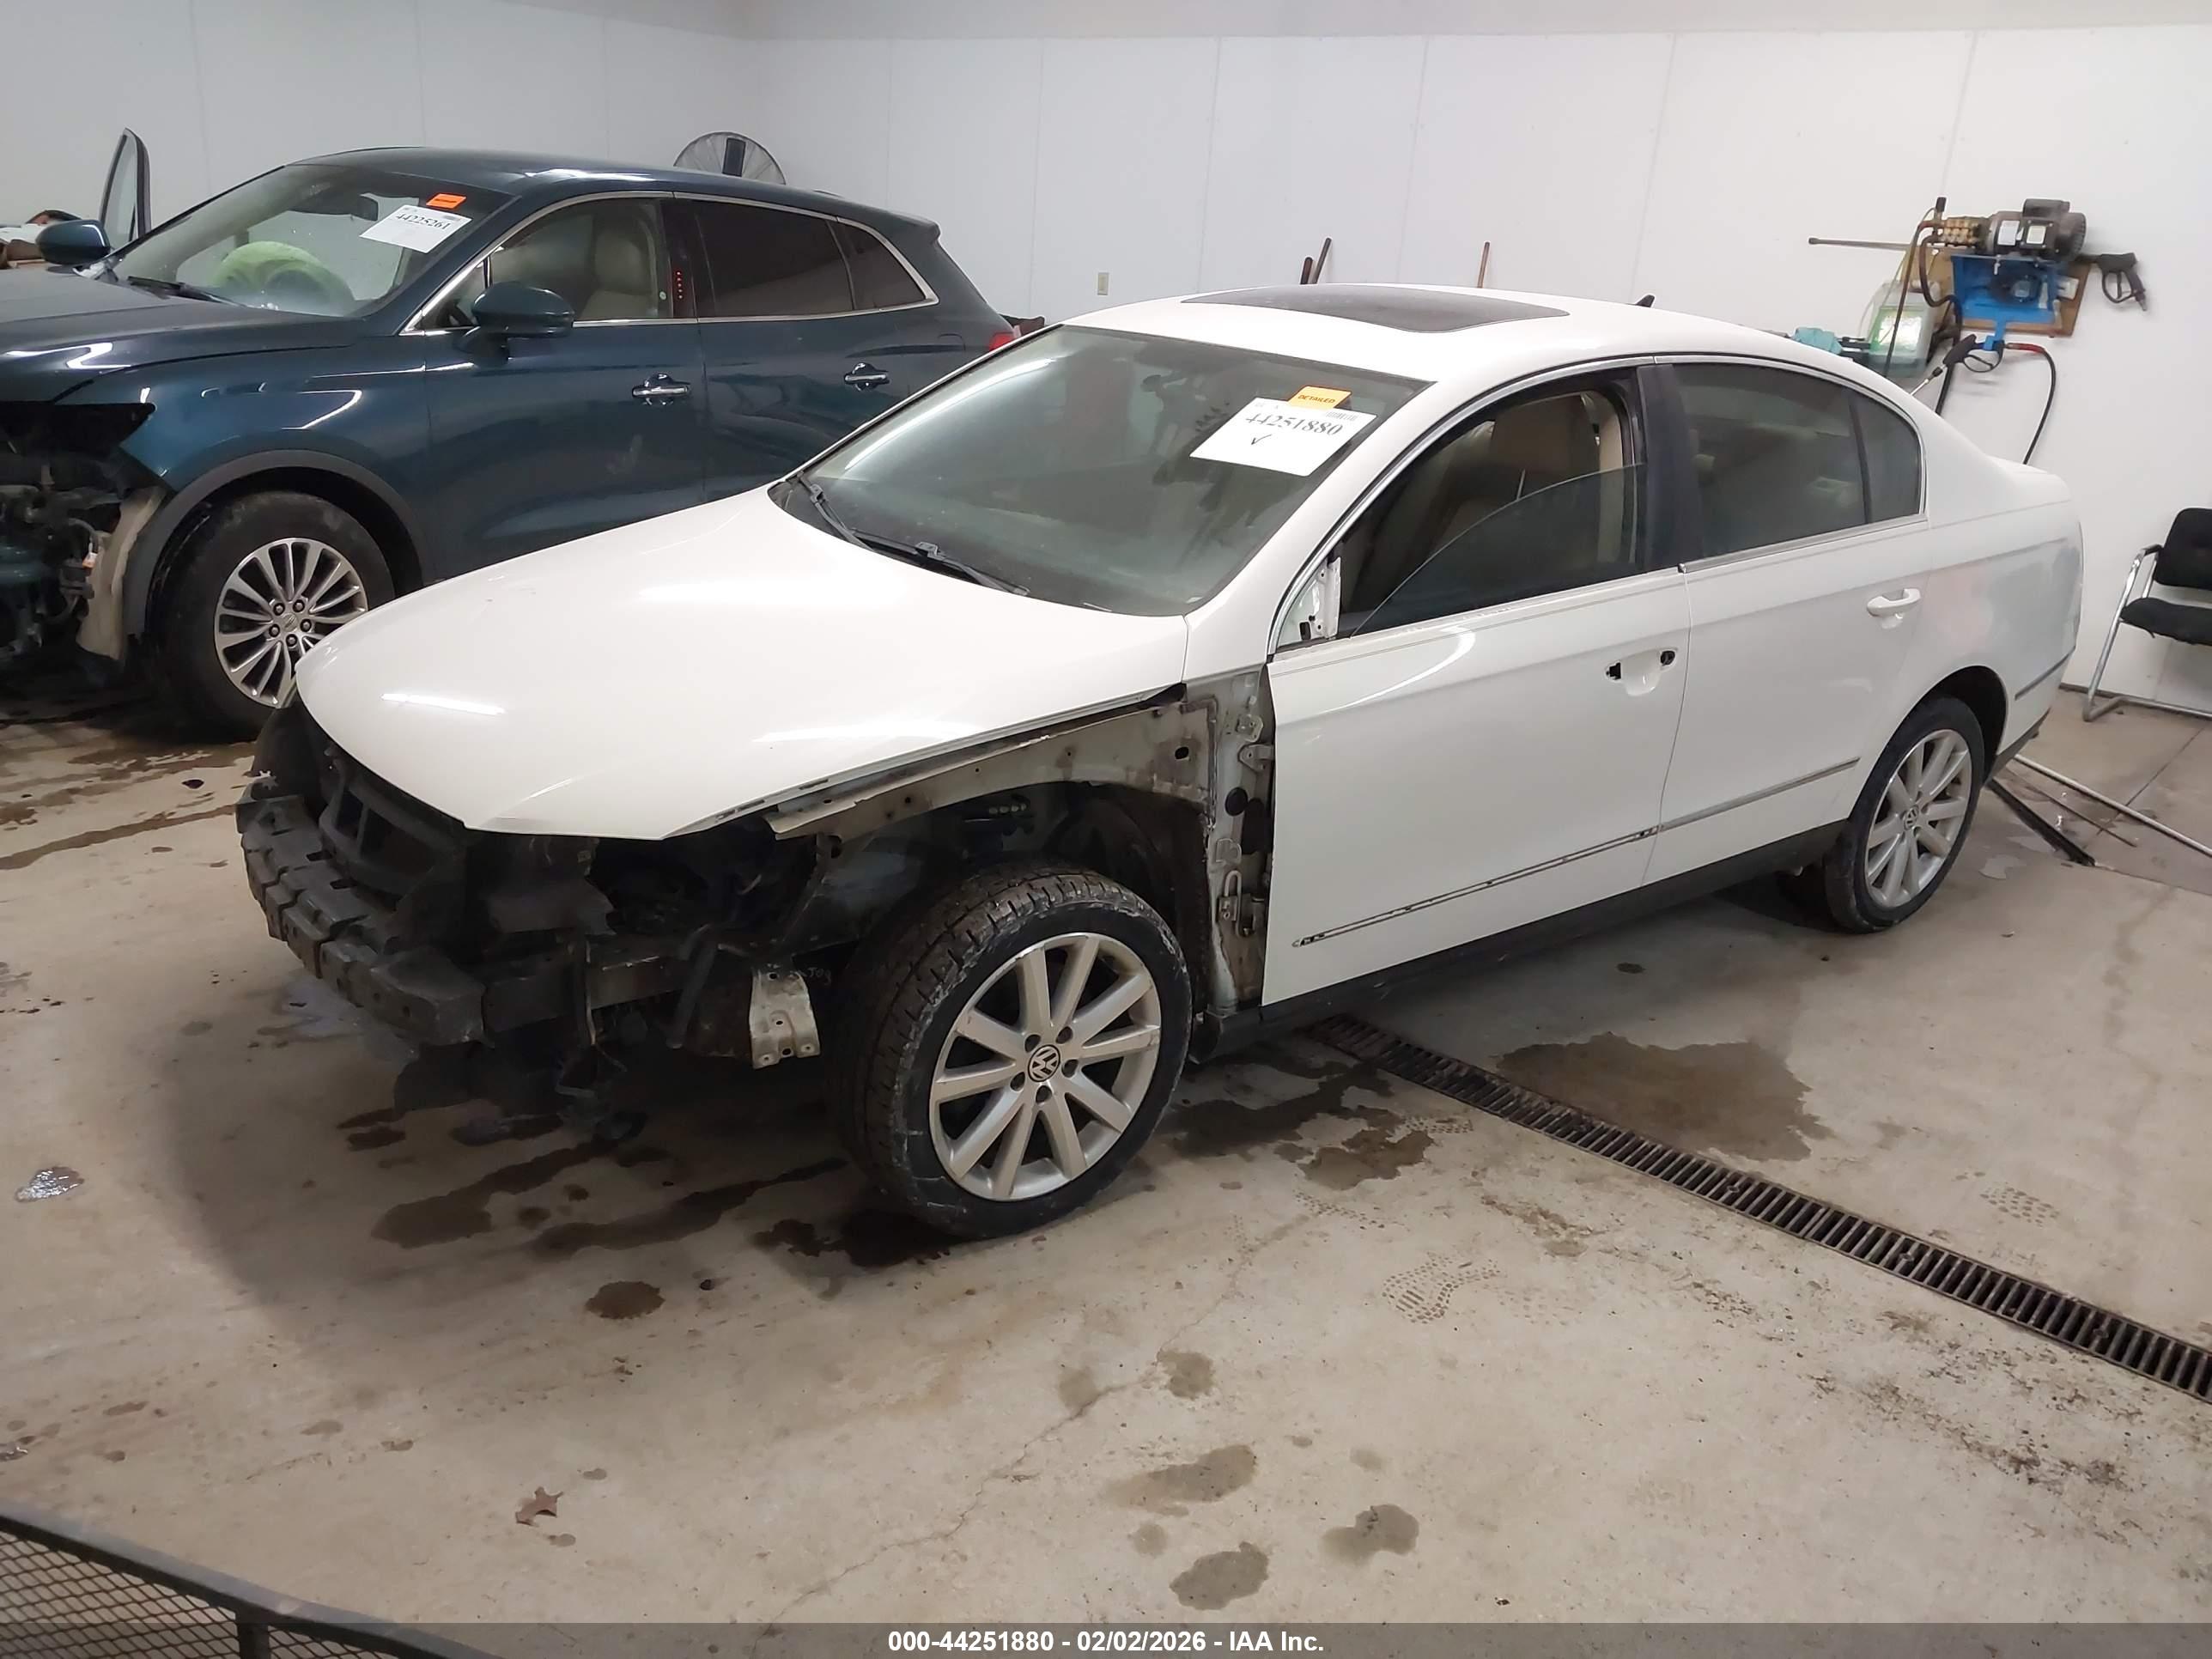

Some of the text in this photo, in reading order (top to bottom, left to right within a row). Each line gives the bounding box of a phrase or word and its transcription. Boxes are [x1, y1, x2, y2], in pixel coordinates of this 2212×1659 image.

[396, 213, 451, 230] 44225261
[1297, 394, 1336, 404] DETAILED
[1245, 413, 1343, 435] 44251880
[1029, 1045, 1060, 1082] VW
